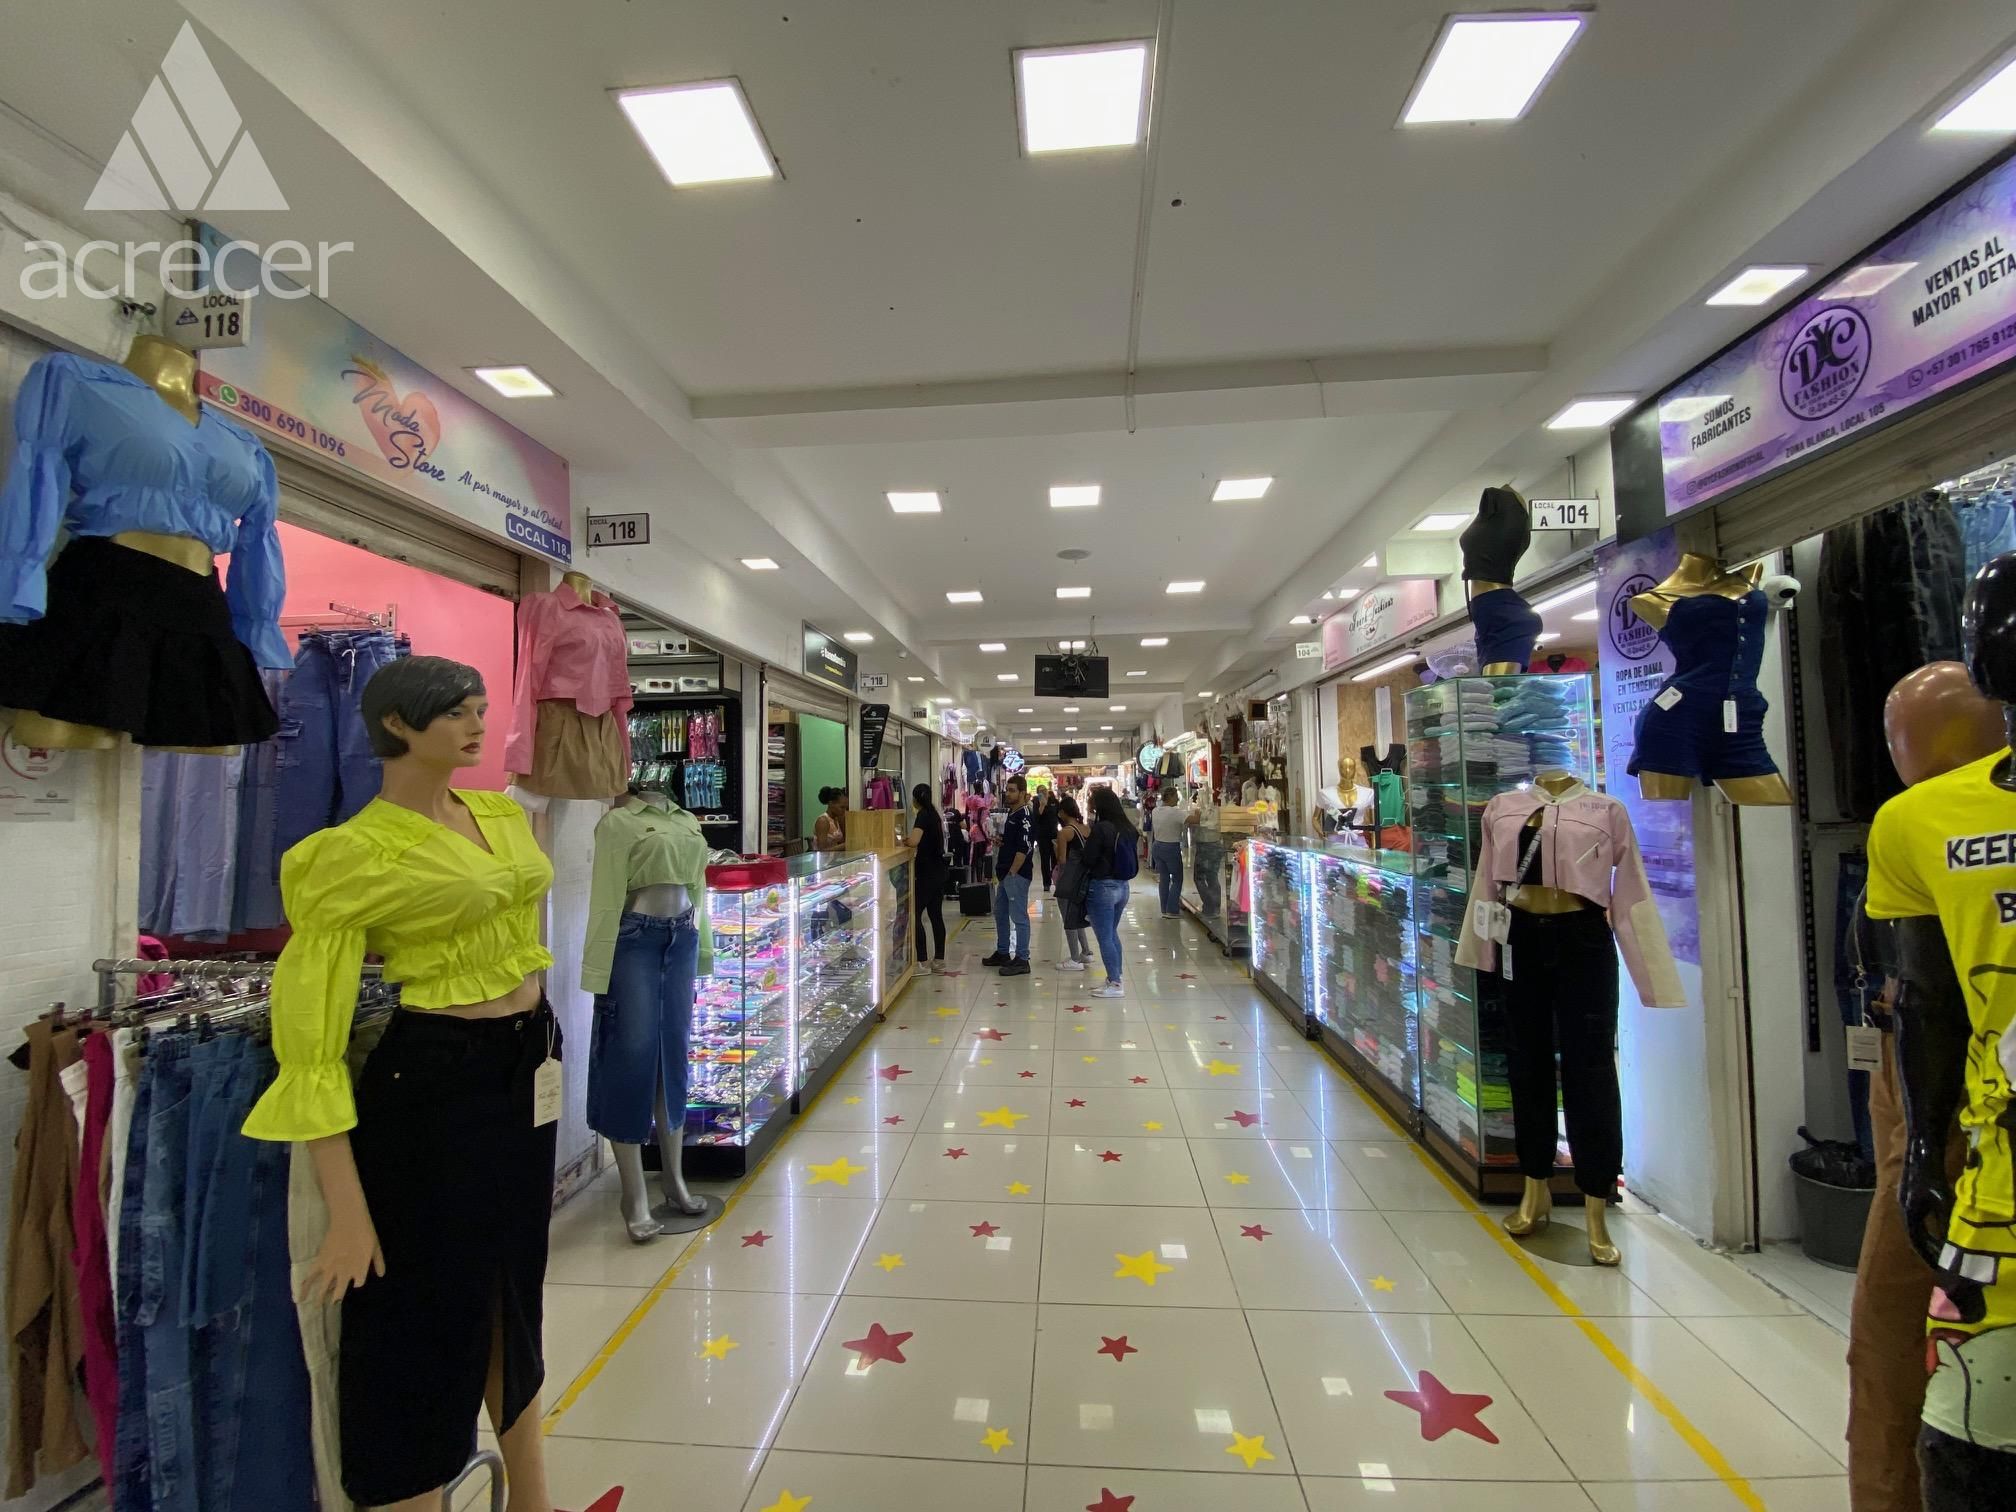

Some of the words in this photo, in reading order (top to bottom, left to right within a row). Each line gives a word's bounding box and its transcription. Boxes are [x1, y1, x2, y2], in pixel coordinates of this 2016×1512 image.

[1925, 249, 1980, 295] VENTAS
[1985, 236, 2004, 262] AL
[203, 294, 240, 309] LOCAL
[1912, 286, 1961, 328] MAYOR
[1963, 276, 1973, 297] Y
[204, 311, 240, 338] 118
[1968, 336, 1990, 356] 765
[1793, 360, 1860, 407] FASHION
[240, 394, 271, 423] 300
[276, 413, 306, 438] 690
[311, 427, 346, 458] 1096
[1703, 397, 1735, 426] SOMOS
[1840, 410, 1867, 432] LOCAL
[1868, 401, 1885, 419] 105
[1691, 406, 1752, 451] FABRICANTES
[389, 430, 446, 482] Store
[457, 470, 473, 486] Al
[472, 481, 491, 495] por
[492, 489, 521, 511] mayor
[522, 505, 529, 517] y
[1540, 515, 1548, 527] A
[1557, 504, 1589, 524] 104
[507, 518, 549, 549] LOCAL
[551, 538, 567, 557] 118
[594, 532, 602, 543] A
[608, 520, 636, 540] 118
[870, 676, 883, 686] 118
[1615, 669, 1633, 682] ROPA
[1633, 666, 1643, 678] DE
[1643, 661, 1664, 675] DAMA
[1618, 684, 1627, 696] EN
[1613, 700, 1638, 714] VENTAS
